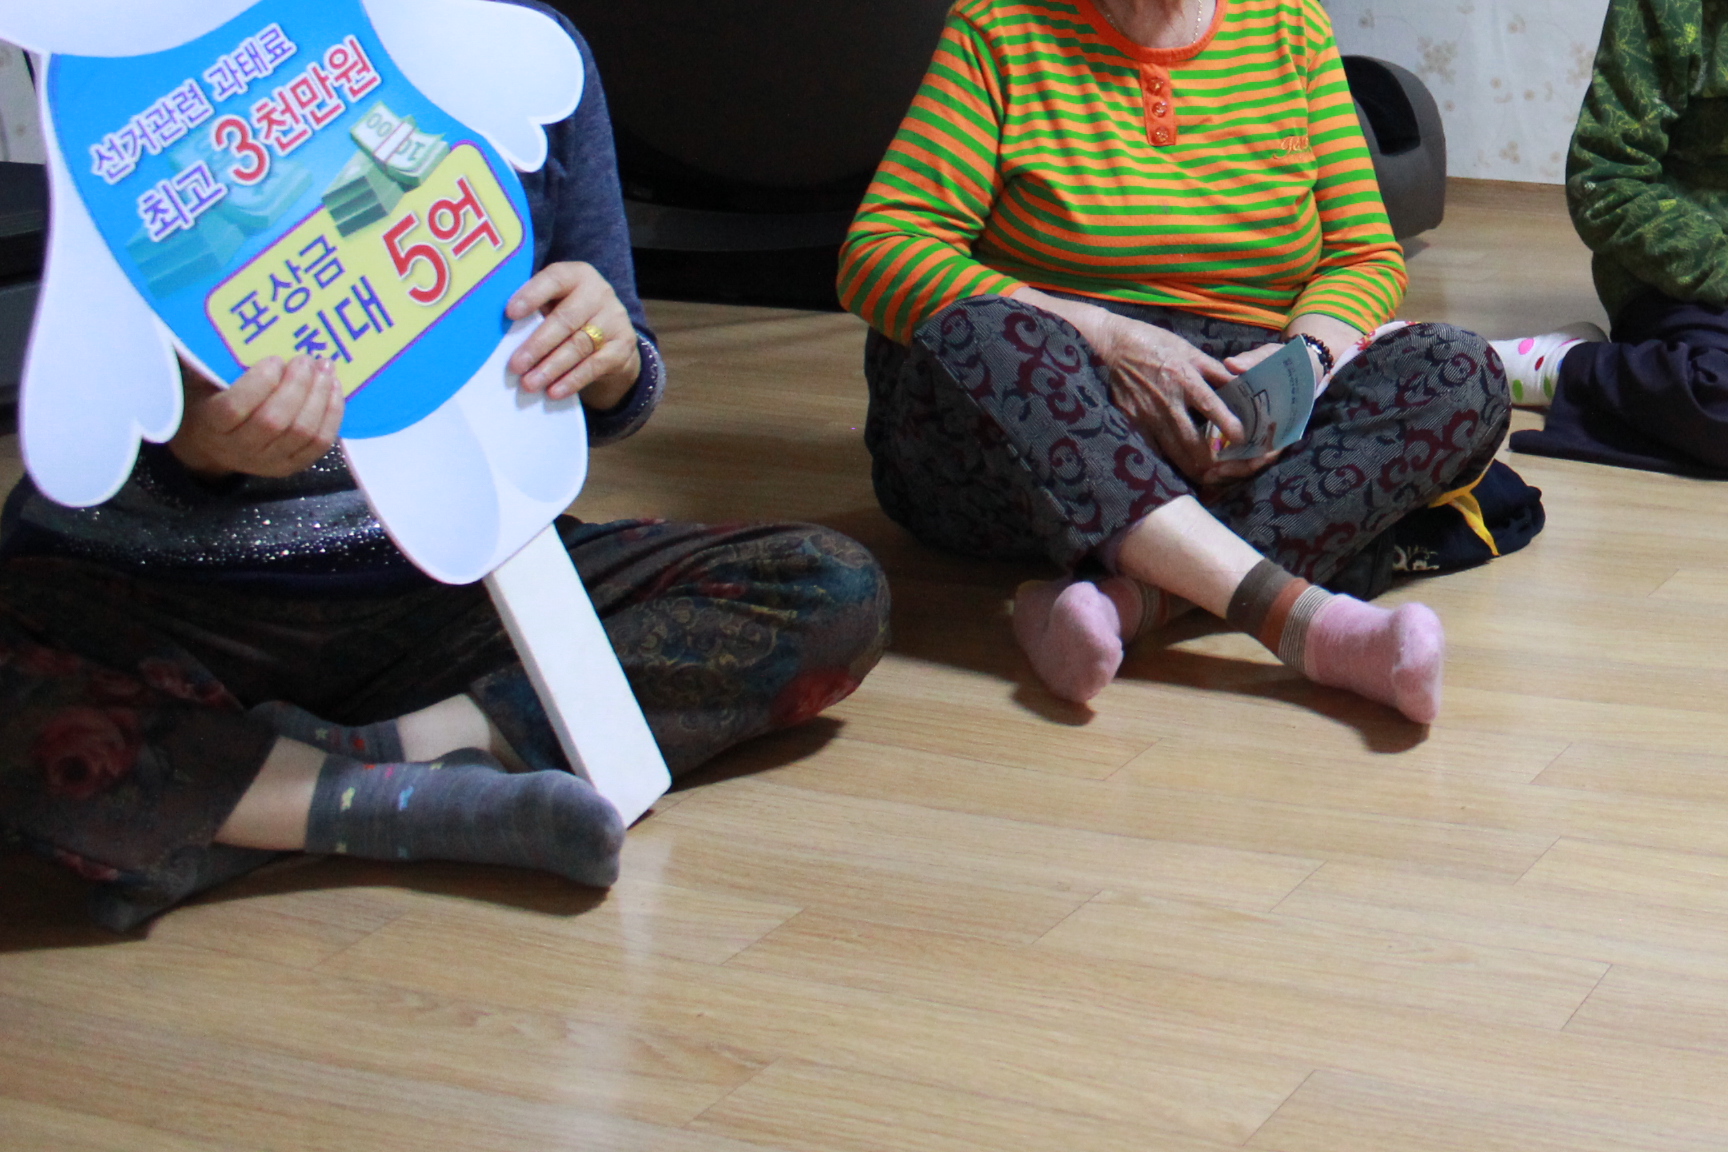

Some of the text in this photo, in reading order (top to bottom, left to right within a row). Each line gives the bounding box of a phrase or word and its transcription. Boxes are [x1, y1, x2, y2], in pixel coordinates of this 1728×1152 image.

[91, 23, 297, 184] 선거관련 과태료
[137, 35, 381, 241] 최고 3천만원
[230, 234, 346, 345] 포상금
[381, 175, 504, 307] 5억
